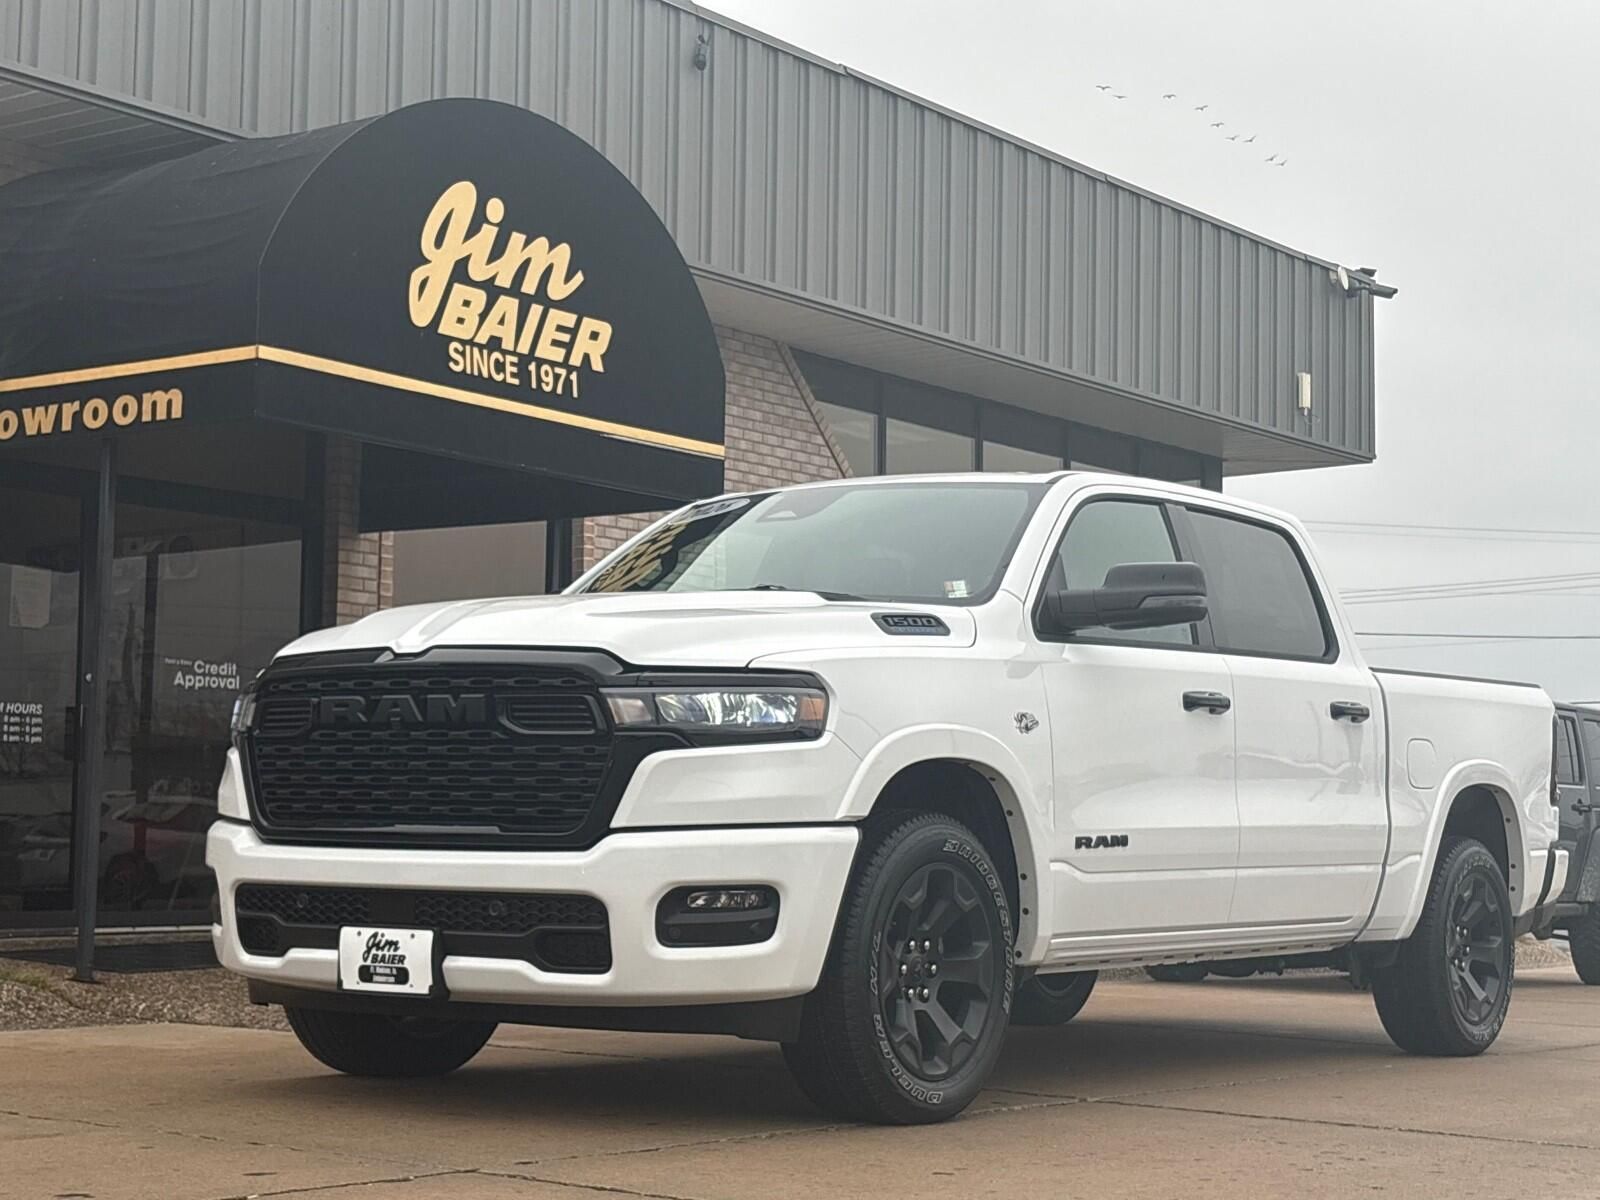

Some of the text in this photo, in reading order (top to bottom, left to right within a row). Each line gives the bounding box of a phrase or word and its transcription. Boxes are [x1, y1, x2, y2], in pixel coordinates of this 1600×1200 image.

[409, 181, 584, 327] Jim
[438, 283, 612, 372] BAIER
[448, 342, 578, 398] SINCE 1971
[0, 388, 183, 440] owroom
[885, 617, 937, 626] 1500
[174, 670, 240, 690] Approval
[194, 660, 237, 676] Credit
[6, 702, 43, 715] HOURS
[320, 695, 486, 723] RAM
[1075, 835, 1128, 849] RAM
[362, 931, 400, 963] Jim
[370, 953, 406, 965] BAIER
